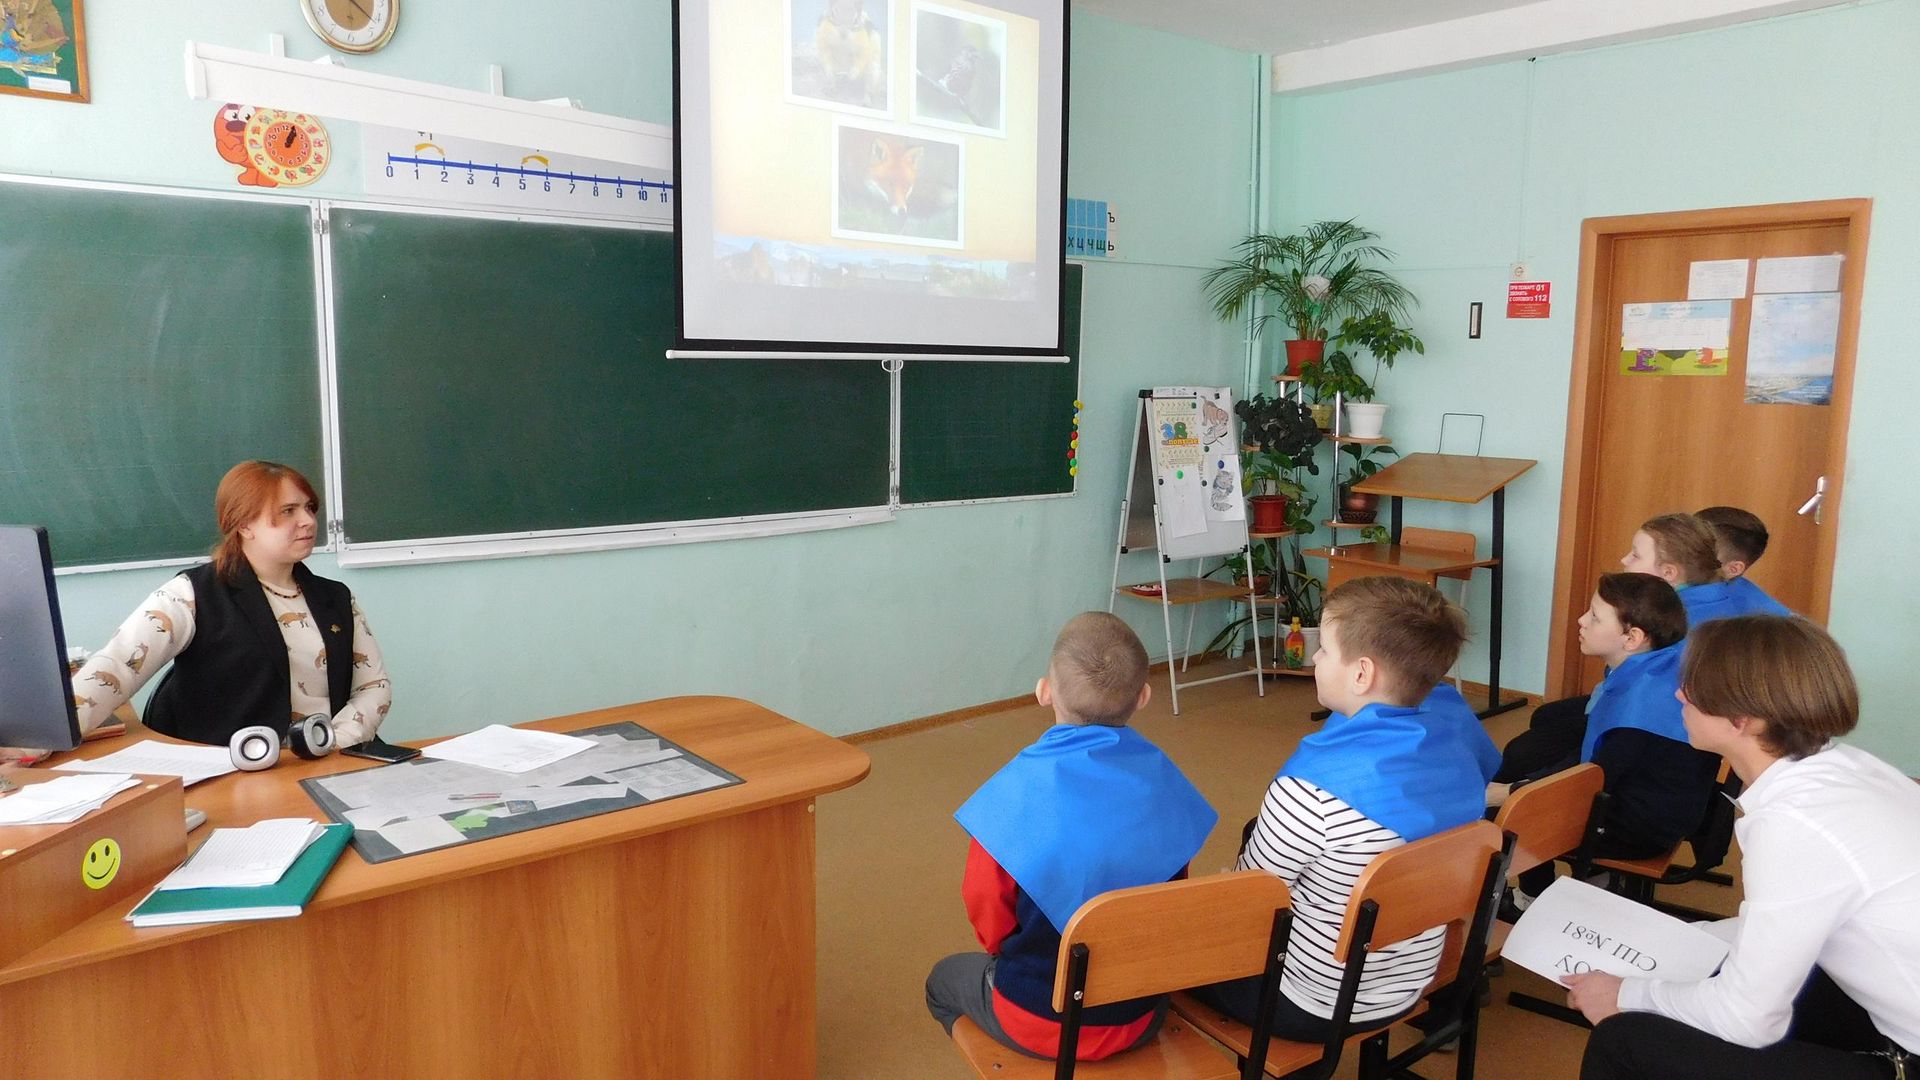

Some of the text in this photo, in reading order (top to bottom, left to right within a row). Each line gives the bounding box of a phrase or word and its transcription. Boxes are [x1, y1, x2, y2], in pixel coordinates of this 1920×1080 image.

[386, 165, 668, 203] 0 1 2 3 4 5 6 7 8 9 10 11
[1087, 238, 1094, 250] Ч
[1535, 284, 1545, 292] 01
[1534, 294, 1548, 302] 112
[1562, 920, 1657, 972] СШ №81
[1554, 954, 1602, 975] ОУ
